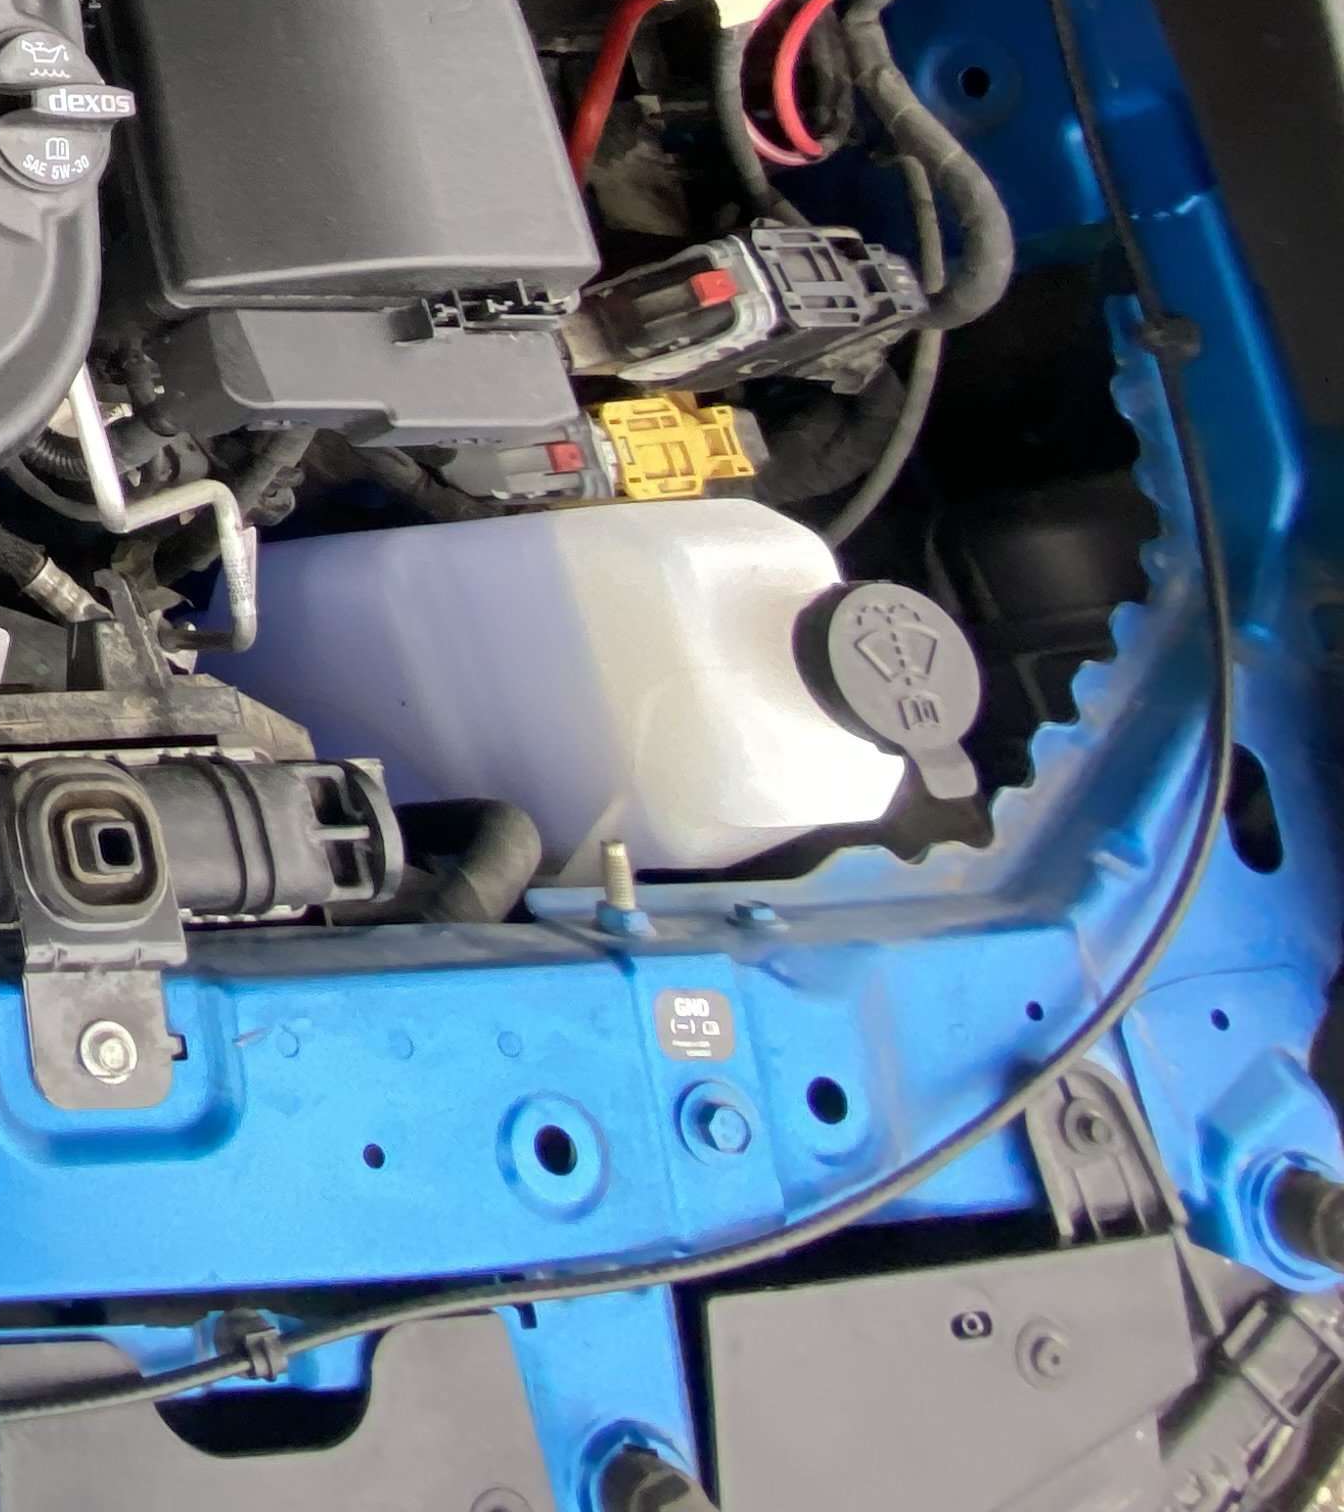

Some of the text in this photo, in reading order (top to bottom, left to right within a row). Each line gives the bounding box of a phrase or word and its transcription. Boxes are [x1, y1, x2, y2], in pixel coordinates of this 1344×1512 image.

[48, 88, 131, 113] dexos
[22, 154, 90, 180] SAE 5W-30
[674, 997, 710, 1017] GND
